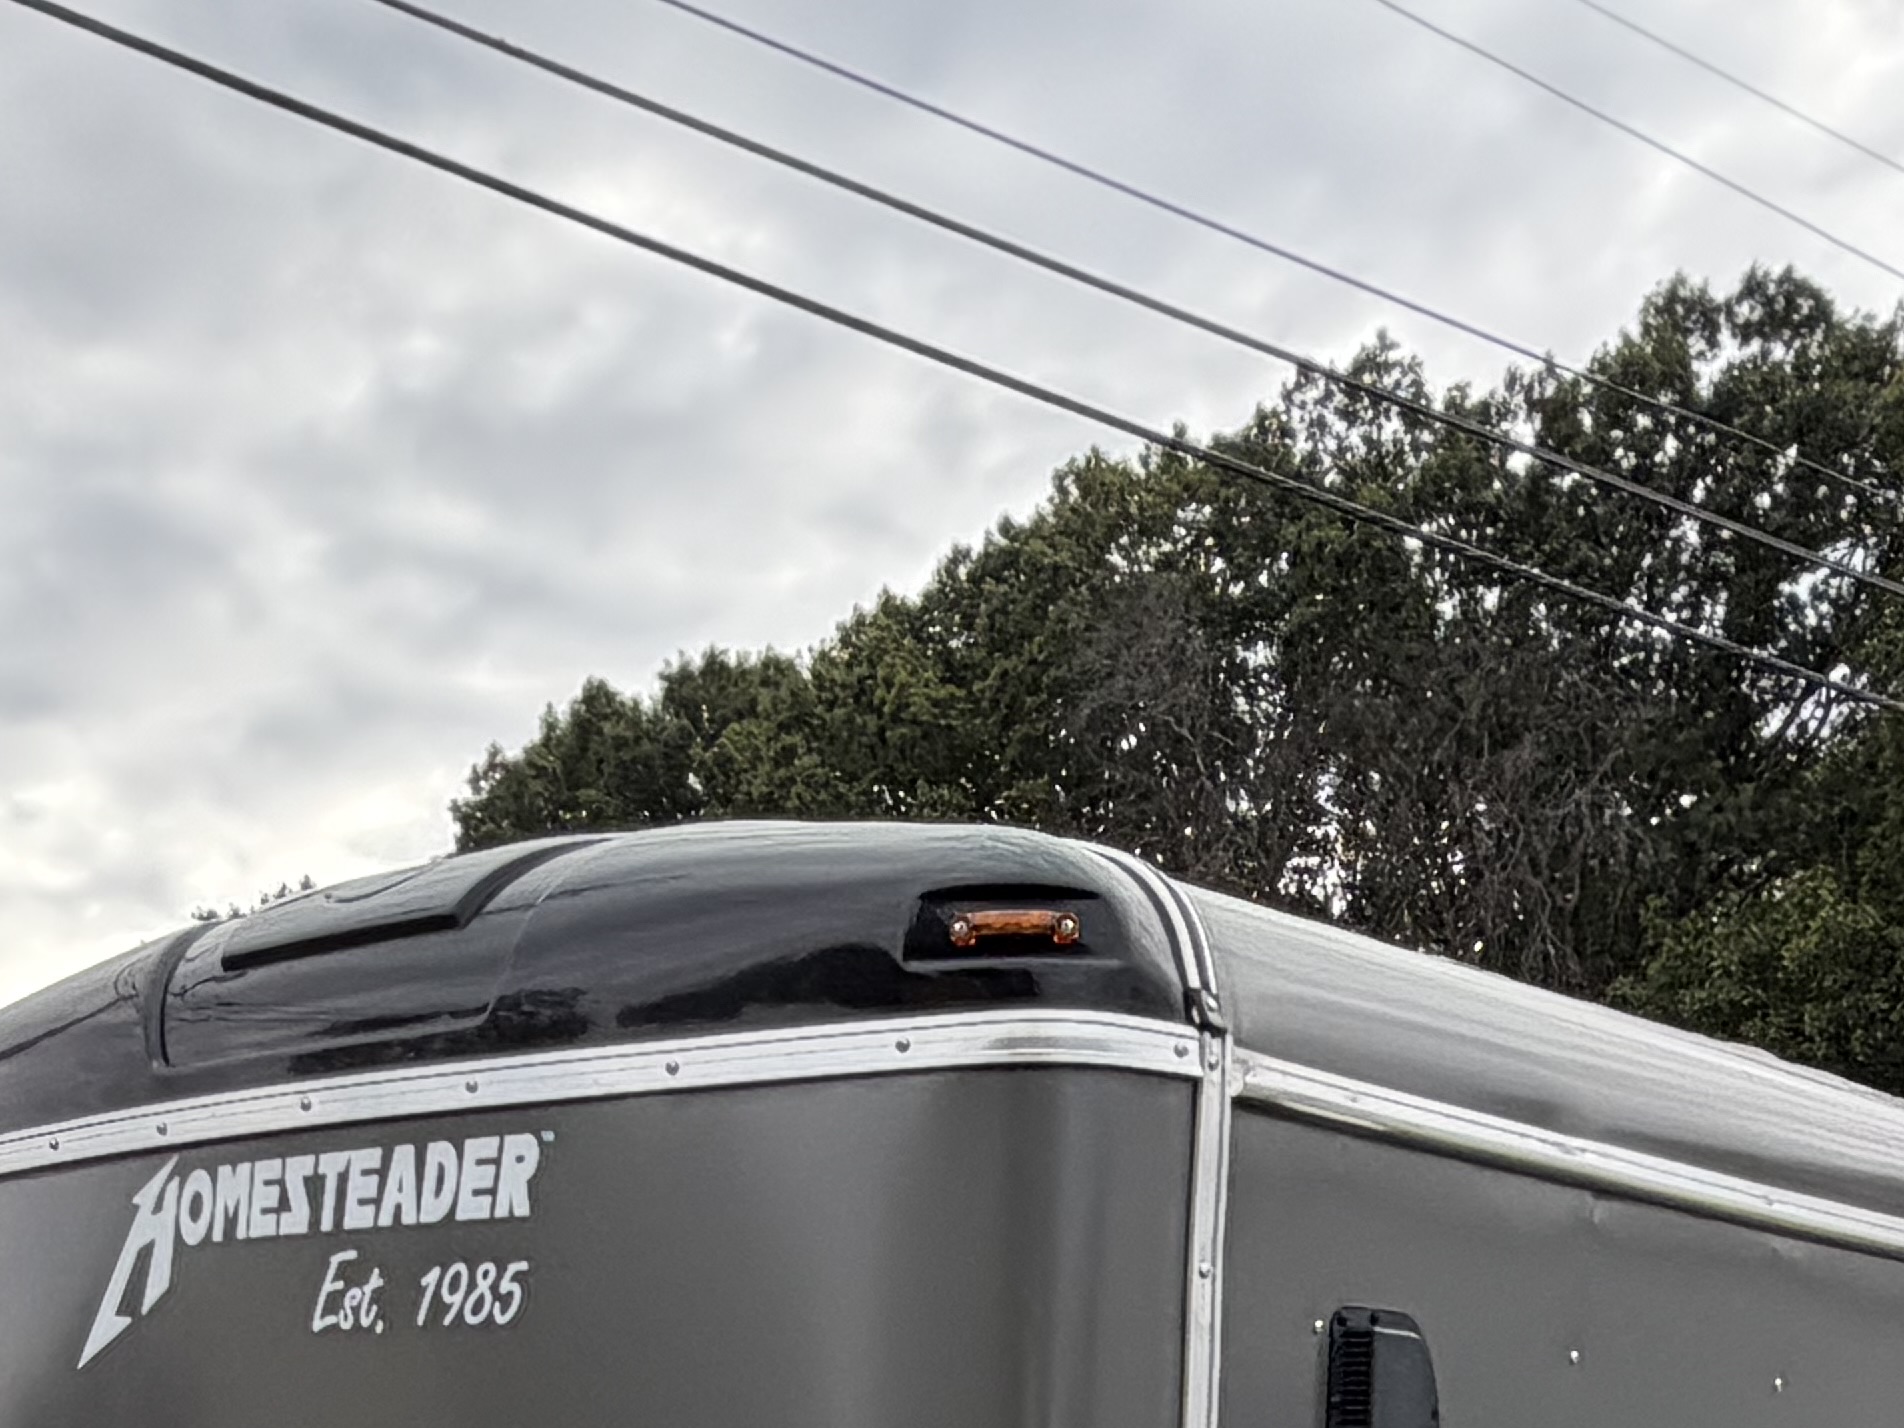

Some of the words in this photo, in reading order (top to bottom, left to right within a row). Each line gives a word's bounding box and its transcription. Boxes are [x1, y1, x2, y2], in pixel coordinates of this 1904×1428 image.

[77, 1132, 540, 1370] HOMESTEADER
[311, 1249, 384, 1335] Est.
[416, 1259, 530, 1328] 1985
